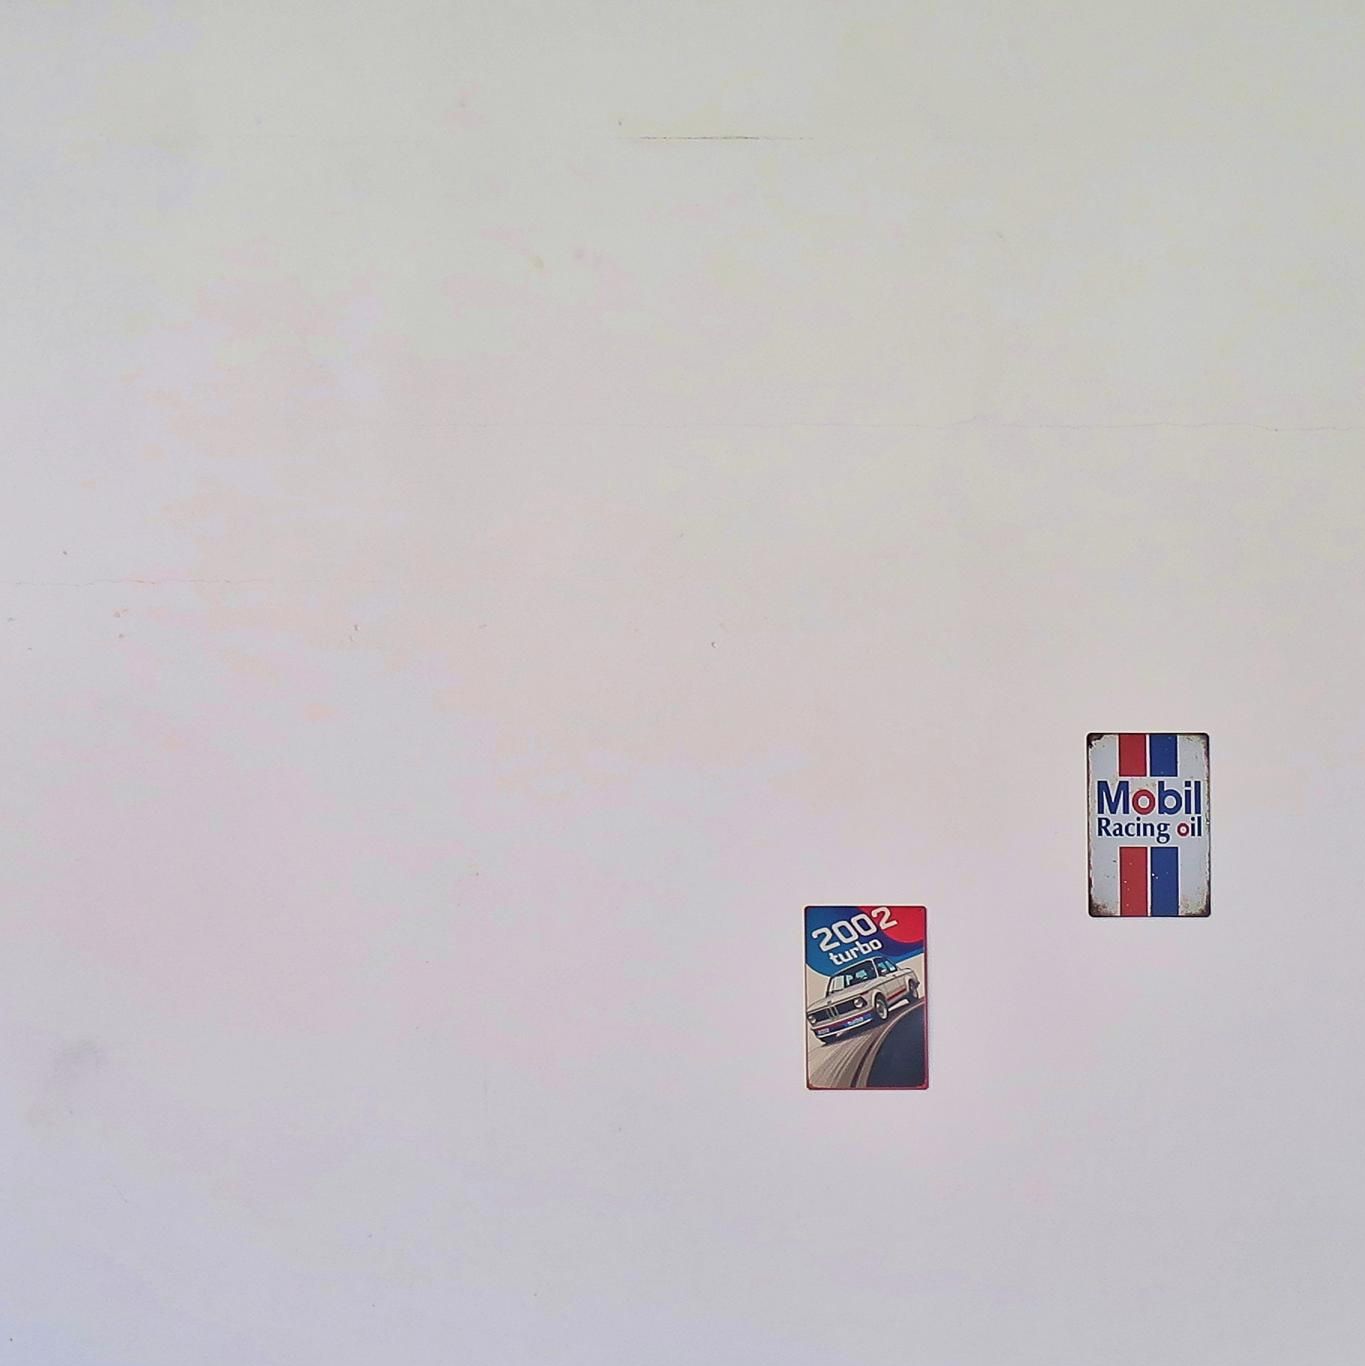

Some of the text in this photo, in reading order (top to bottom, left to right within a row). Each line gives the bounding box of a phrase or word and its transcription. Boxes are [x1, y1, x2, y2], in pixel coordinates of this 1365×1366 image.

[1097, 780, 1201, 815] Mobil
[1098, 816, 1202, 844] Racing oil
[812, 906, 898, 952] 2002
[829, 938, 882, 966] turbo
